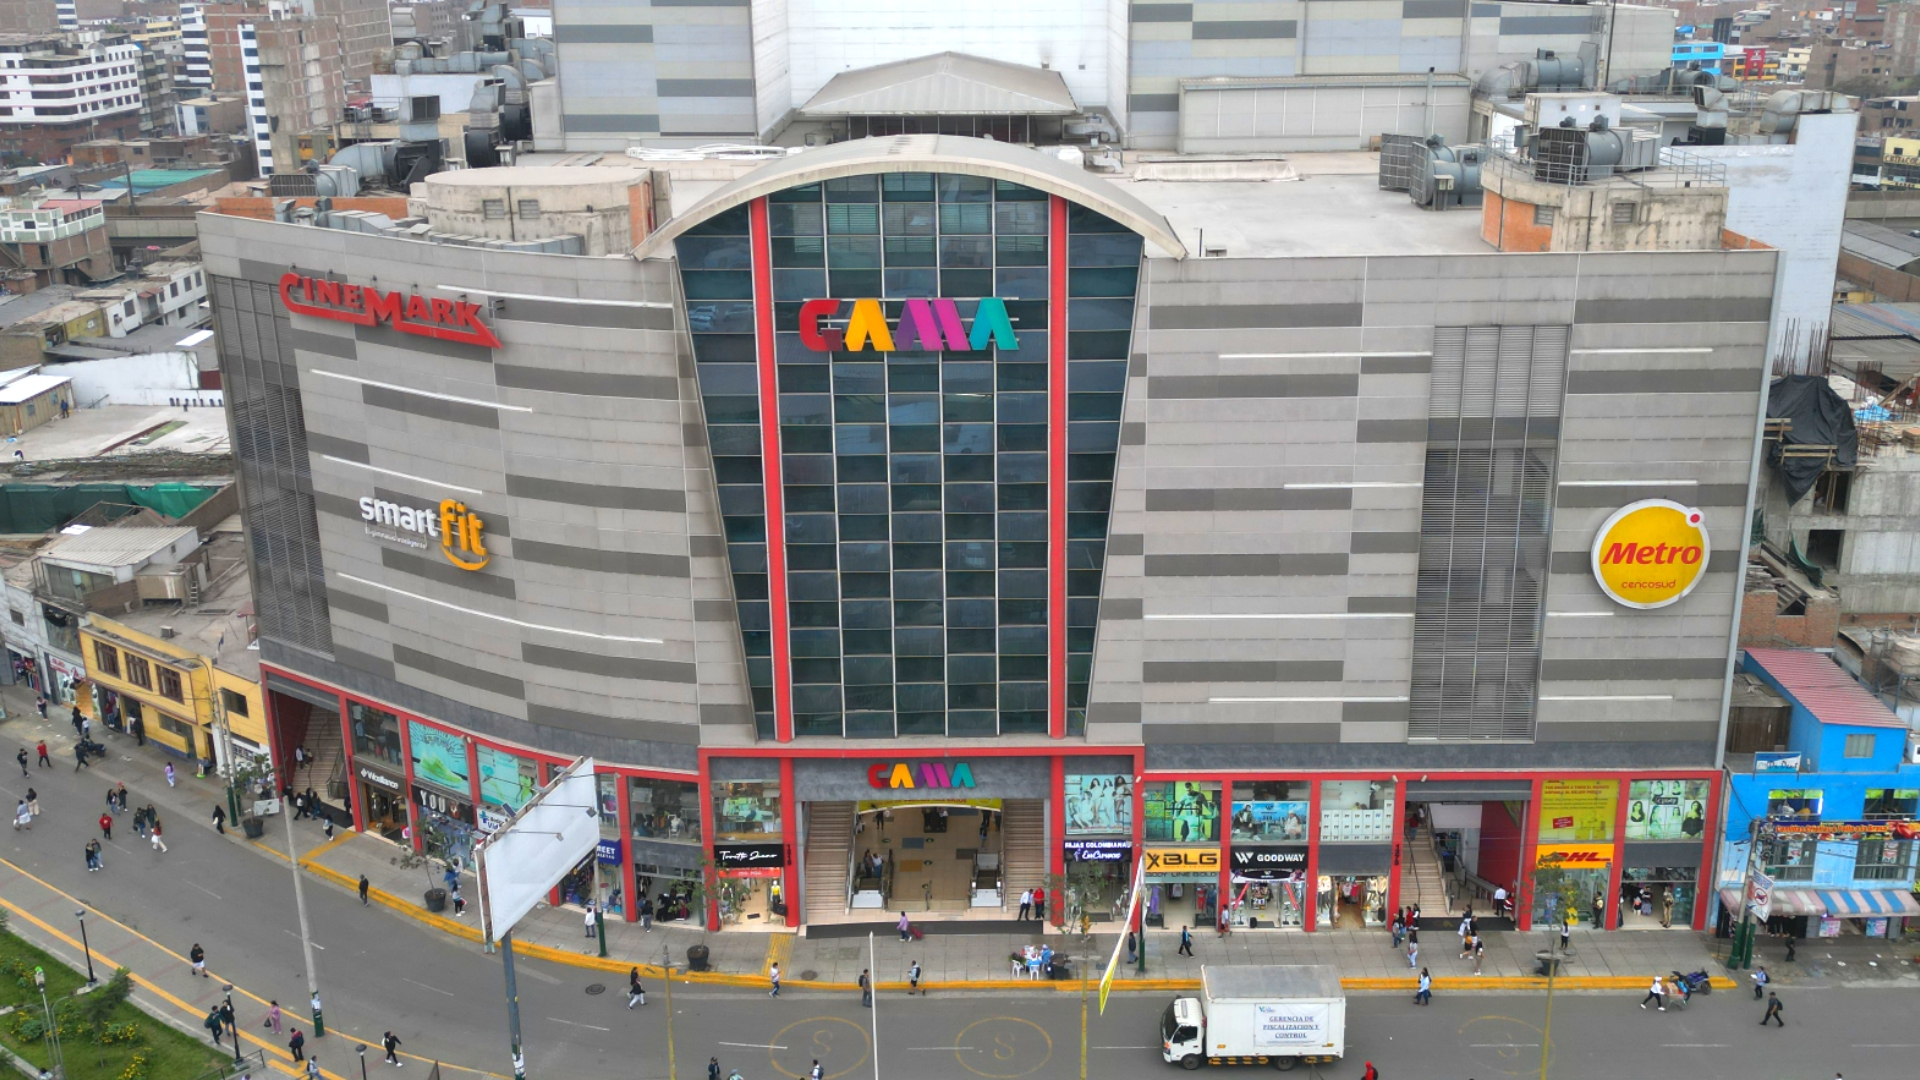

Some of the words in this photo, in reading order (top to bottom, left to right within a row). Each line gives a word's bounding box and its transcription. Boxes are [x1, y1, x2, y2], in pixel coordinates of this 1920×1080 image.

[799, 297, 1020, 352] GAMA
[359, 496, 438, 537] smart
[440, 498, 486, 556] fit
[1602, 542, 1702, 565] Metro
[1621, 580, 1676, 589] cencosud
[867, 762, 976, 789] GAMA
[1163, 853, 1217, 865] BLG
[1257, 854, 1305, 862] GOODWAY
